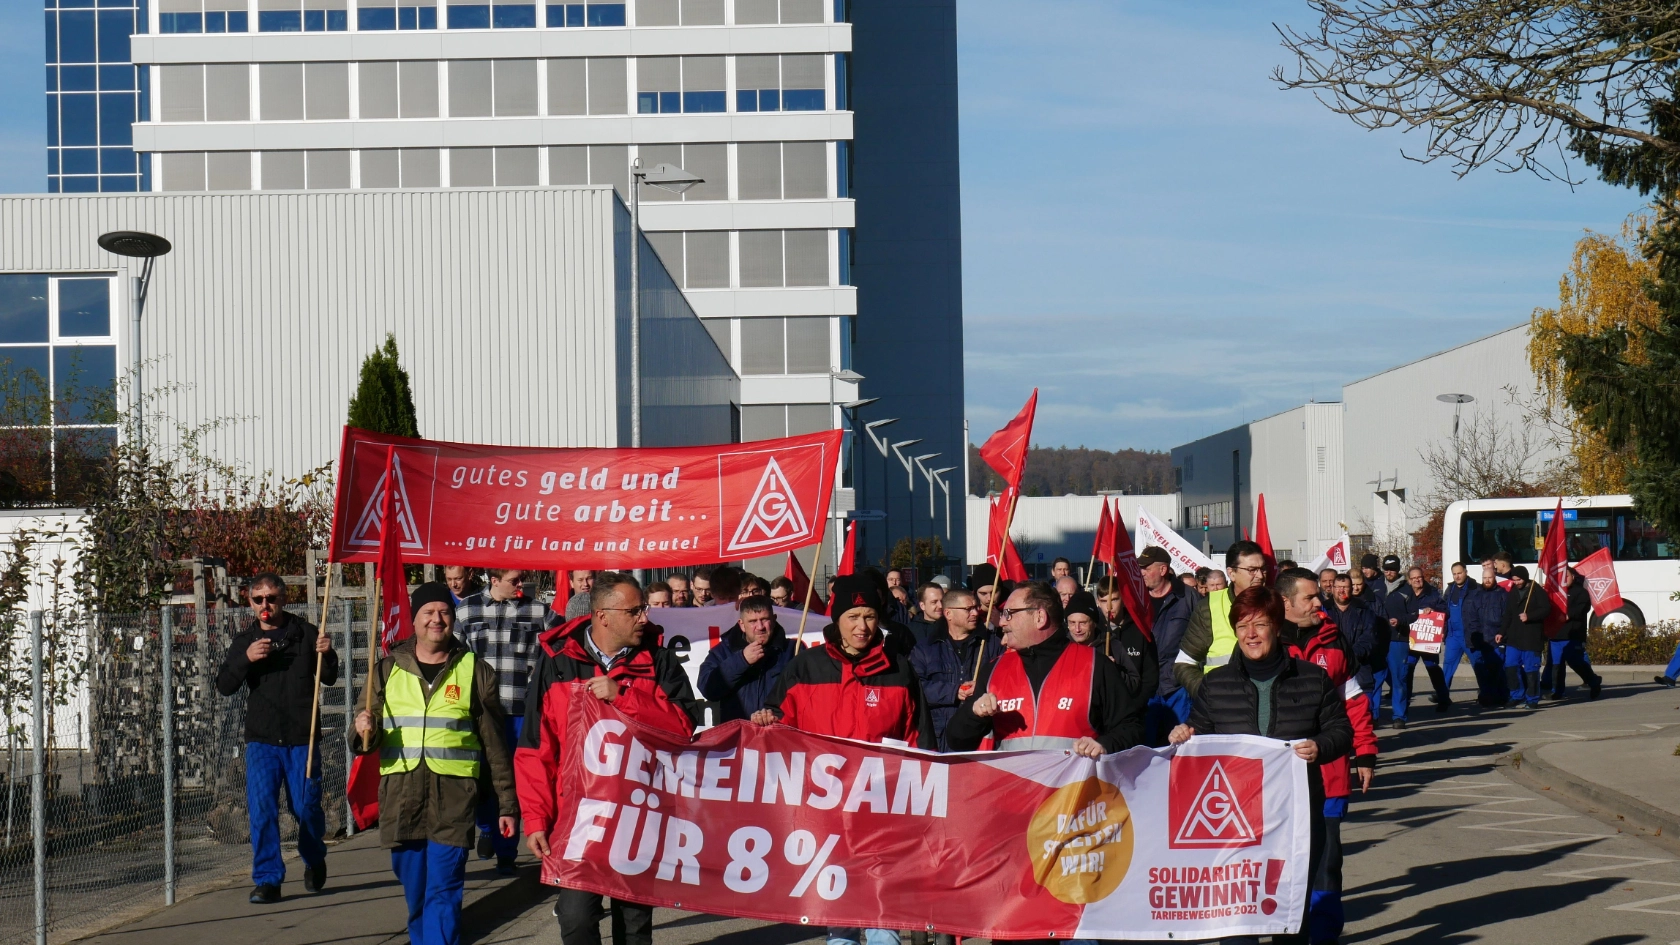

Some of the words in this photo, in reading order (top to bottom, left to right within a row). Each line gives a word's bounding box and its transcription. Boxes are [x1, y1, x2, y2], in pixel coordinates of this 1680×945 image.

[451, 465, 528, 489] gutes
[539, 467, 609, 495] geld
[621, 467, 680, 490] und
[495, 500, 560, 525] gute
[504, 536, 533, 552] für
[541, 537, 585, 551] land
[594, 538, 630, 551] und
[638, 536, 699, 551] leute!
[1153, 529, 1170, 549] WEIL
[1169, 547, 1181, 557] ES
[1416, 632, 1435, 642] WIR
[1058, 697, 1073, 710] 8!
[584, 719, 949, 818] GEMEINSAM
[1057, 800, 1107, 835] DAFÜR
[563, 788, 703, 886] FÜR
[1060, 851, 1105, 877] WIR!
[1149, 859, 1262, 884] SOLIDARITÄT
[1151, 908, 1231, 921] TARIFBEWEGUNG
[1234, 905, 1258, 915] 2022
